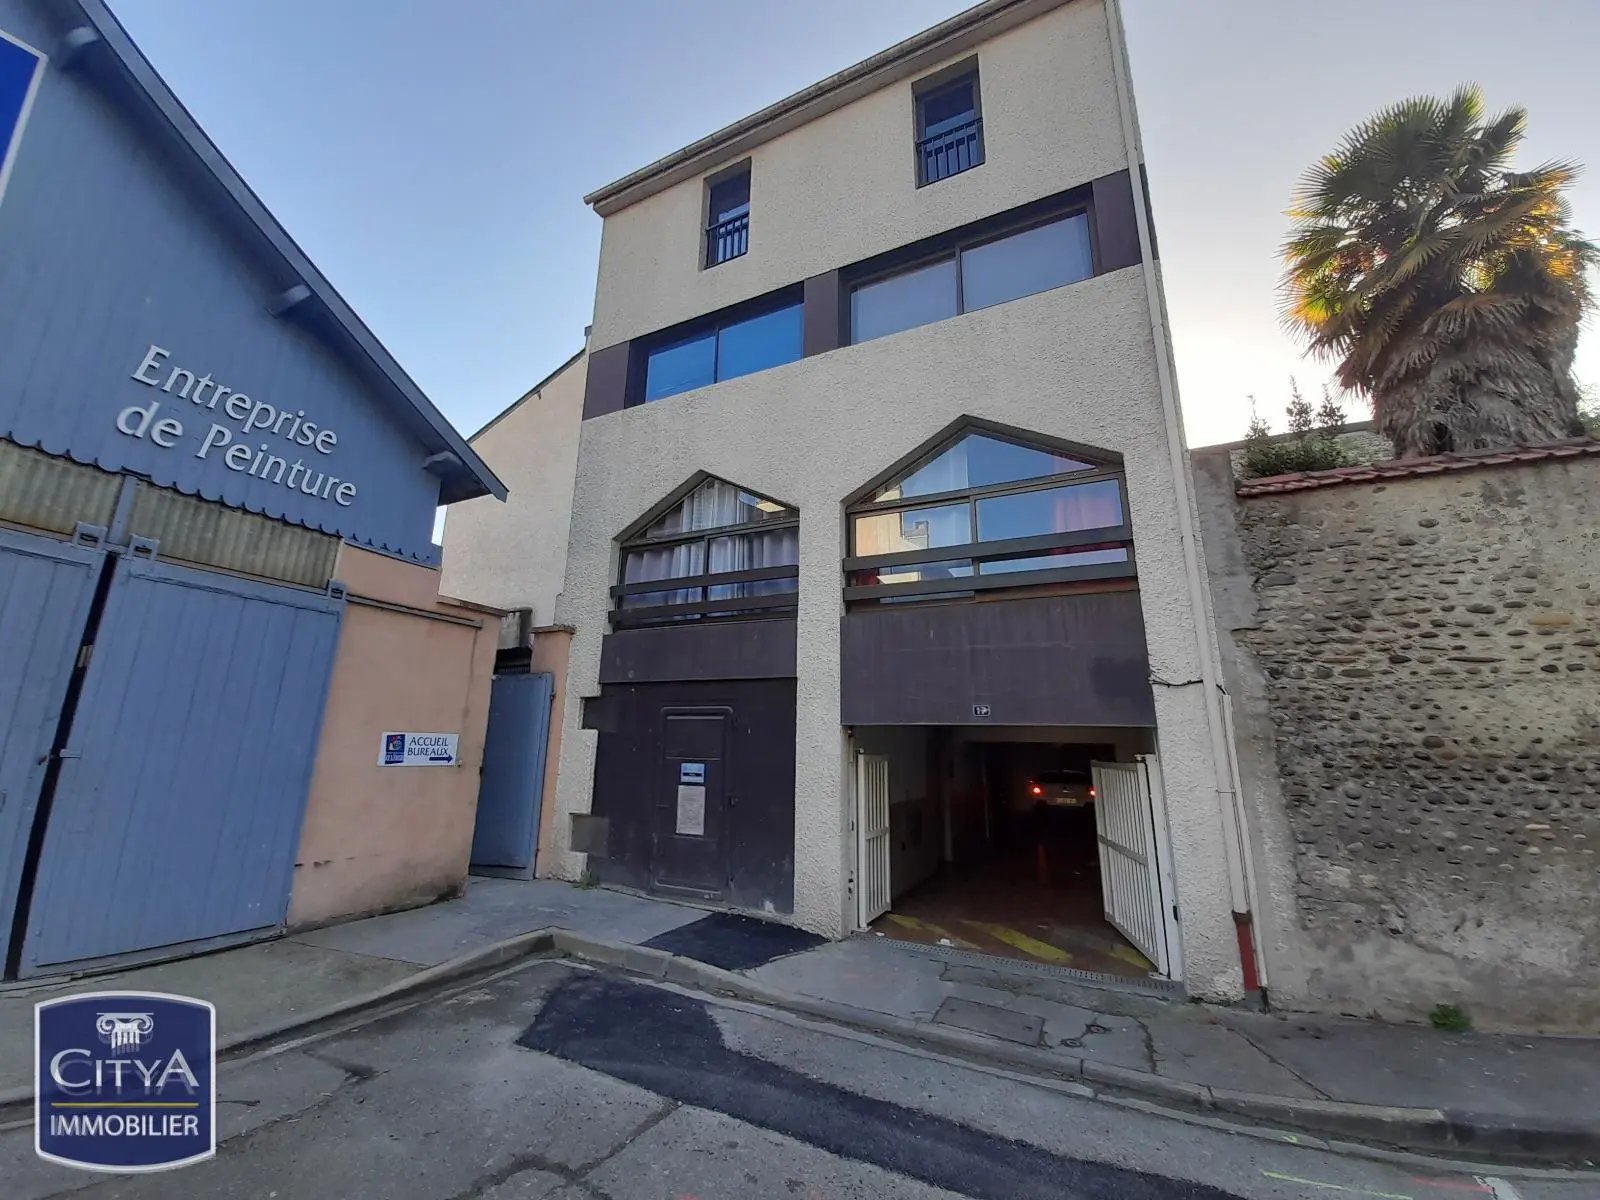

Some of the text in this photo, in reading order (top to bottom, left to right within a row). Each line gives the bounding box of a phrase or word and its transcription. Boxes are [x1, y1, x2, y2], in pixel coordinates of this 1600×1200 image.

[130, 344, 338, 454] Entreprise
[116, 401, 357, 506] de Peinture
[407, 747, 449, 756] BUREAUX
[409, 736, 449, 747] ACCUEIL
